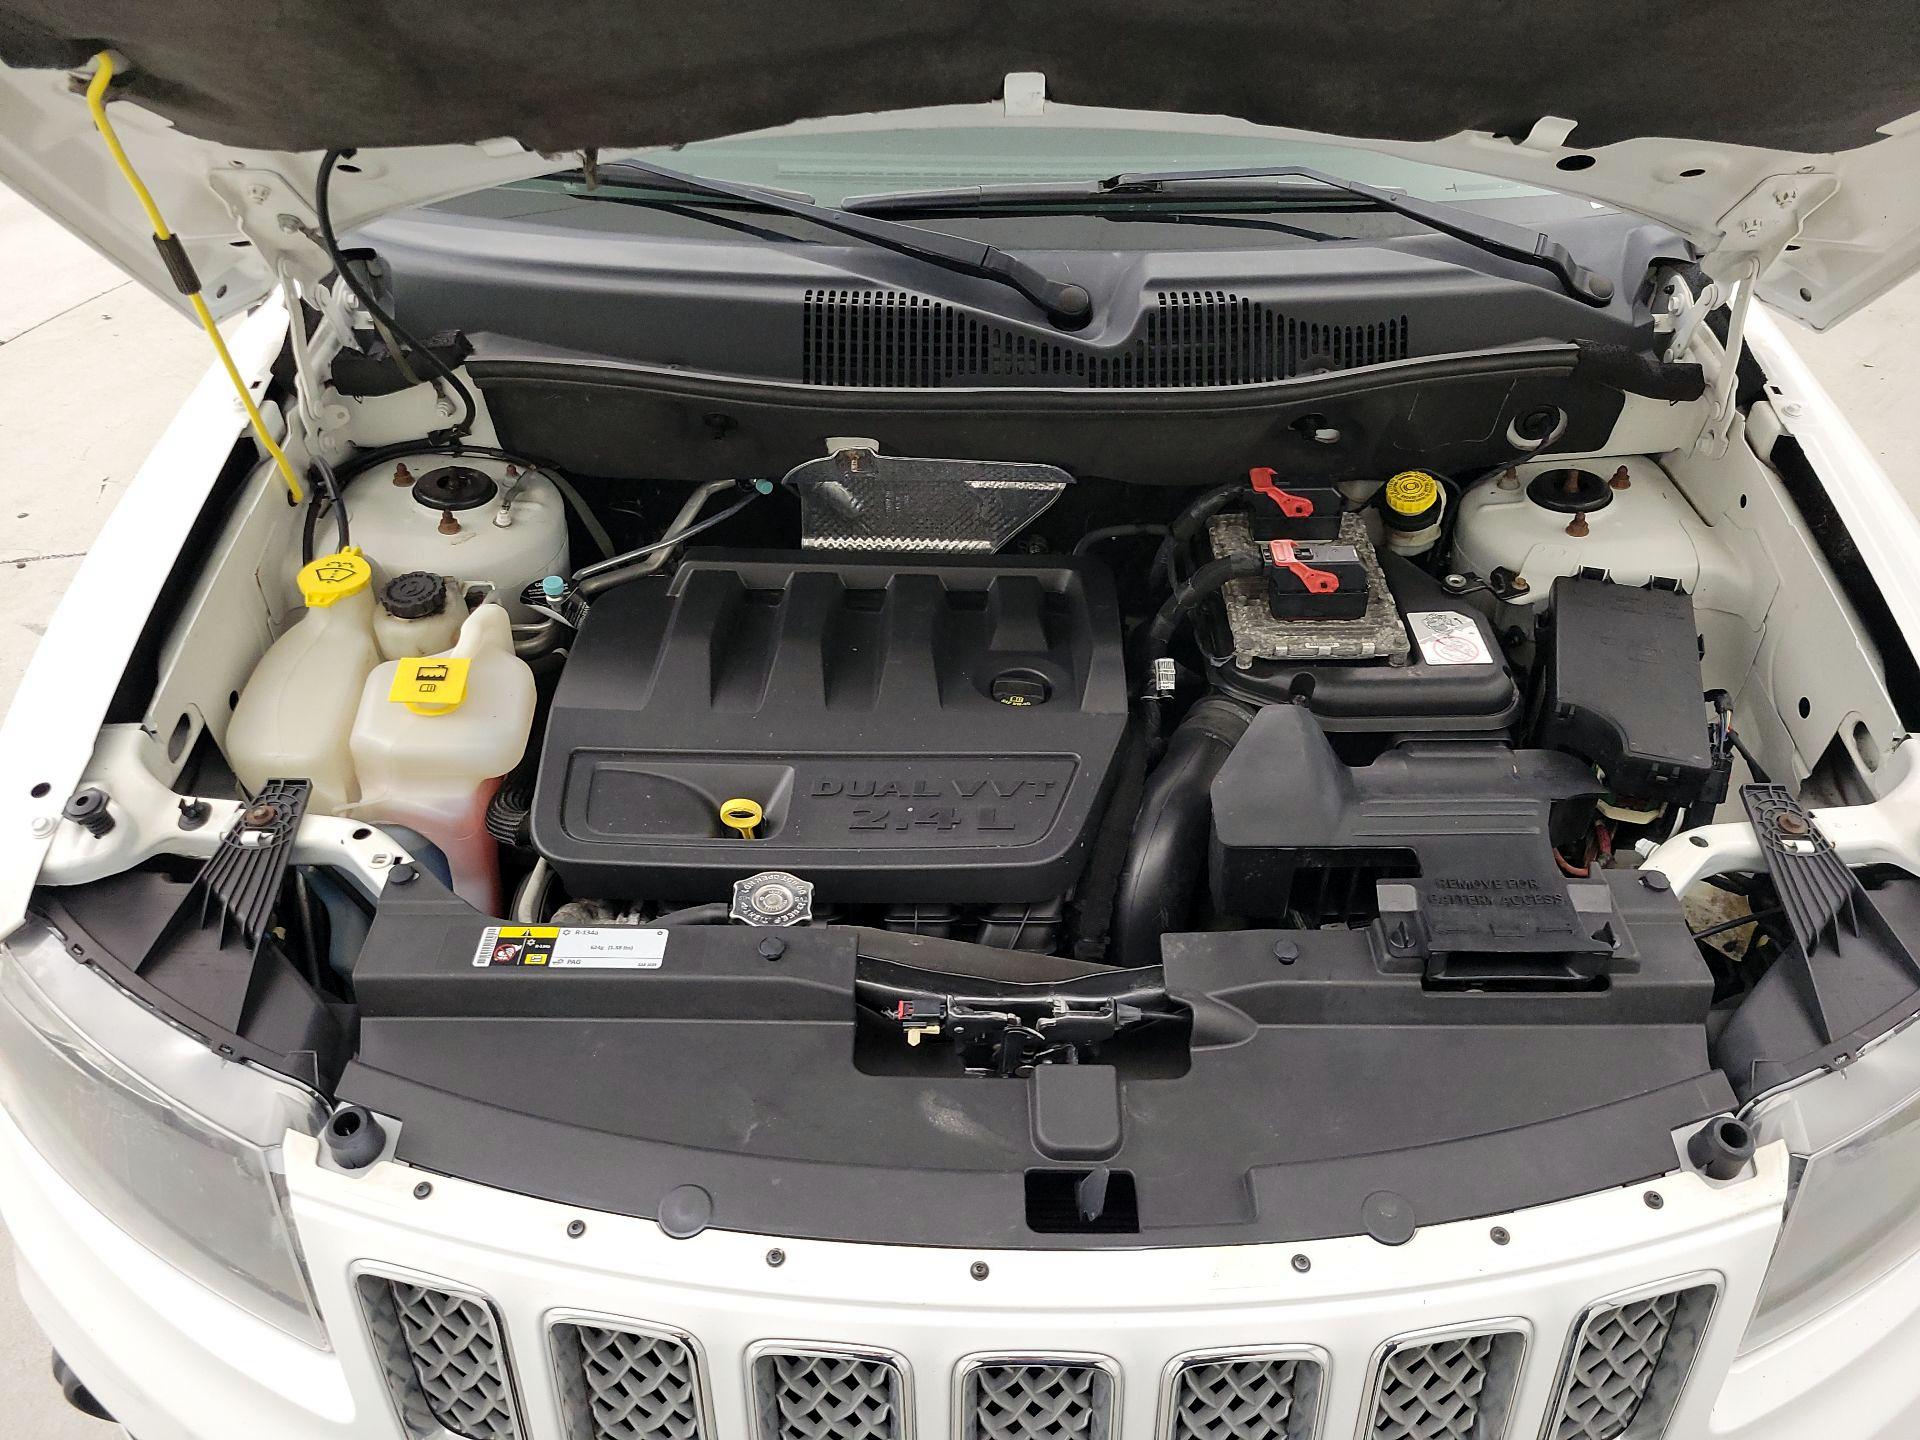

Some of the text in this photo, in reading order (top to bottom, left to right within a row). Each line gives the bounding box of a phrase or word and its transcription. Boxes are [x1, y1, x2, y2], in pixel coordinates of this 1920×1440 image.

[810, 779, 1055, 798] DUAL VVT
[848, 808, 1016, 831] 2.4L
[1434, 878, 1542, 891] REMOVE FOR
[1426, 893, 1564, 907] BATTERY ACCESS
